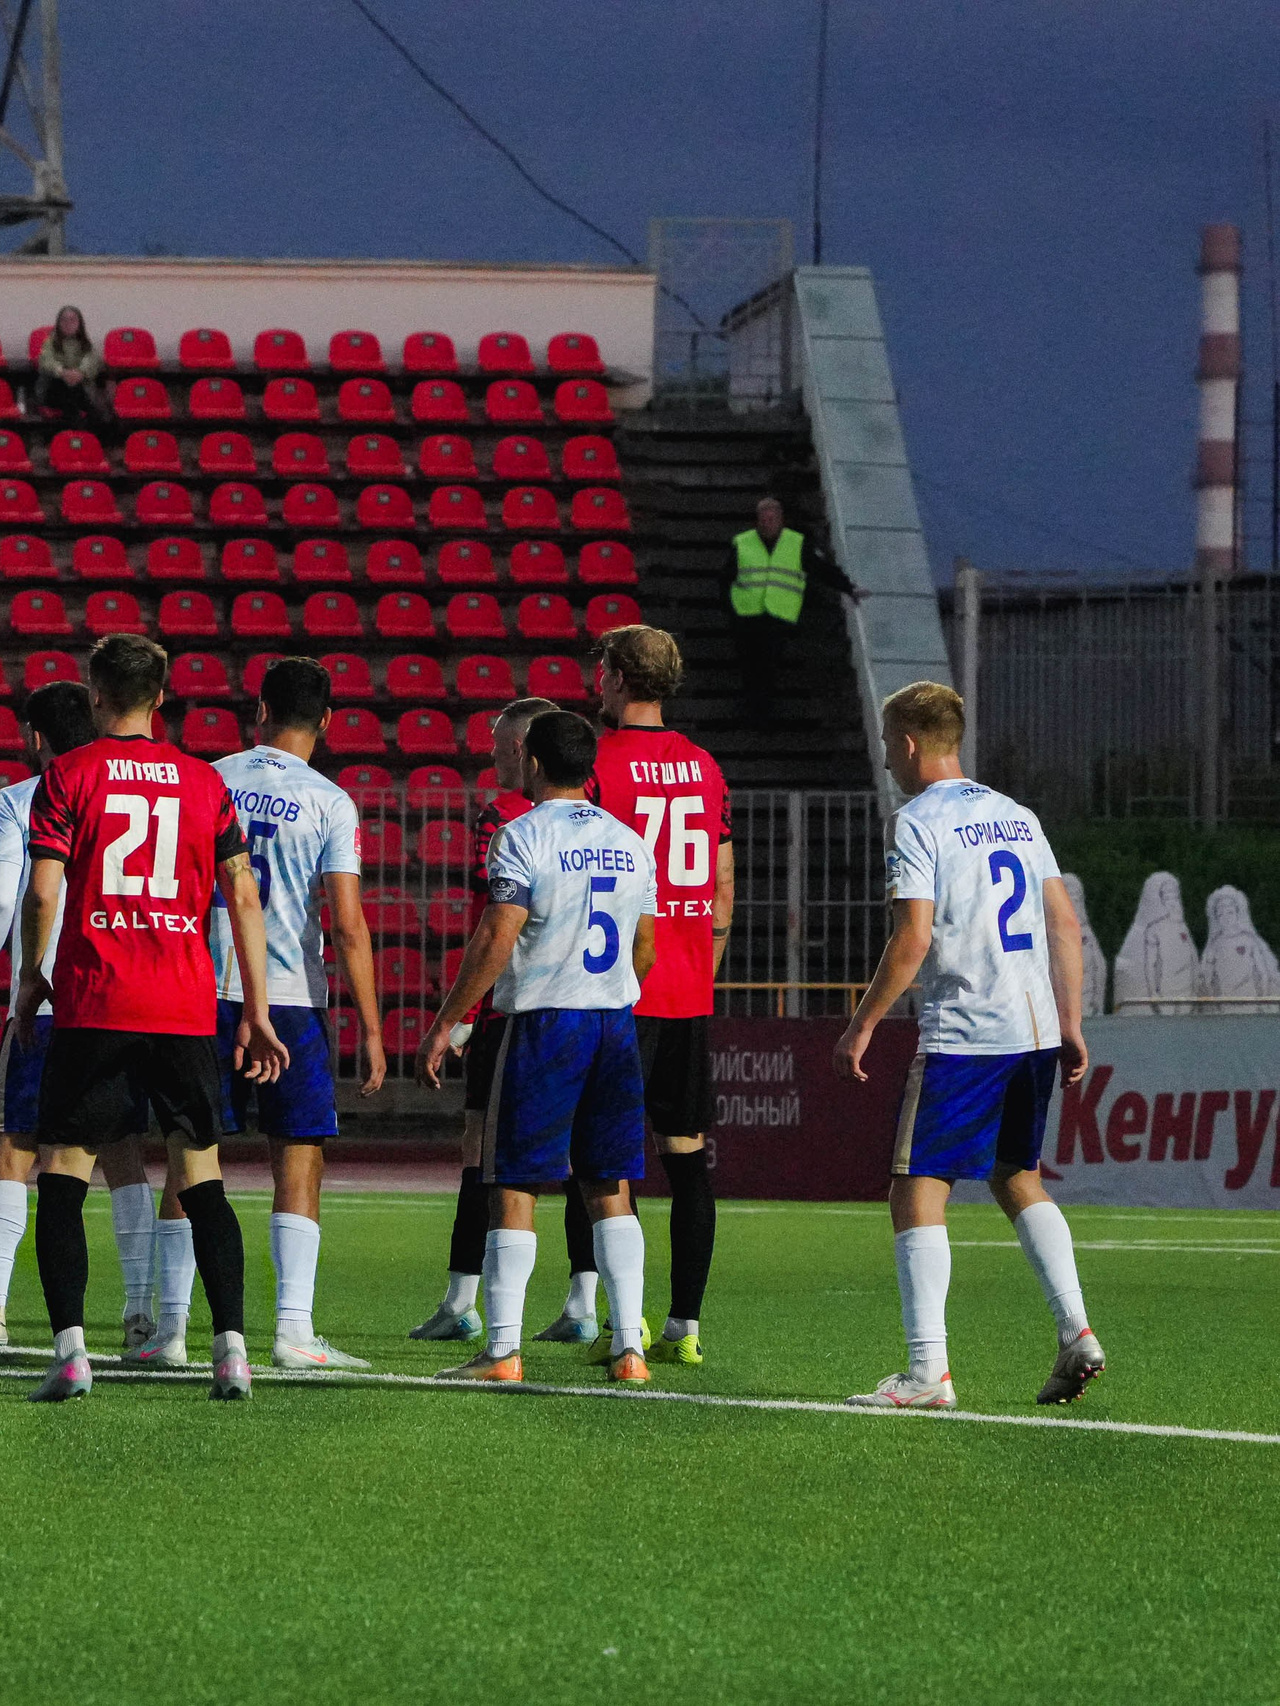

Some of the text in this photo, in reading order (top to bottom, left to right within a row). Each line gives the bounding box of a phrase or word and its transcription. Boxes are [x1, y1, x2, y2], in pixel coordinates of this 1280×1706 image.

[106, 759, 180, 784] ХИТЯЕВ
[629, 760, 703, 785] СТЕШИН
[102, 794, 180, 899] 21
[635, 795, 710, 887] 76
[954, 820, 1033, 848] ТОРМАШЕВ
[89, 910, 198, 934] GALTEX
[583, 876, 620, 974] 5
[988, 850, 1033, 953] 2
[709, 1045, 794, 1082] ИЙСКИЙ
[1056, 1065, 1280, 1191] Кенгу
